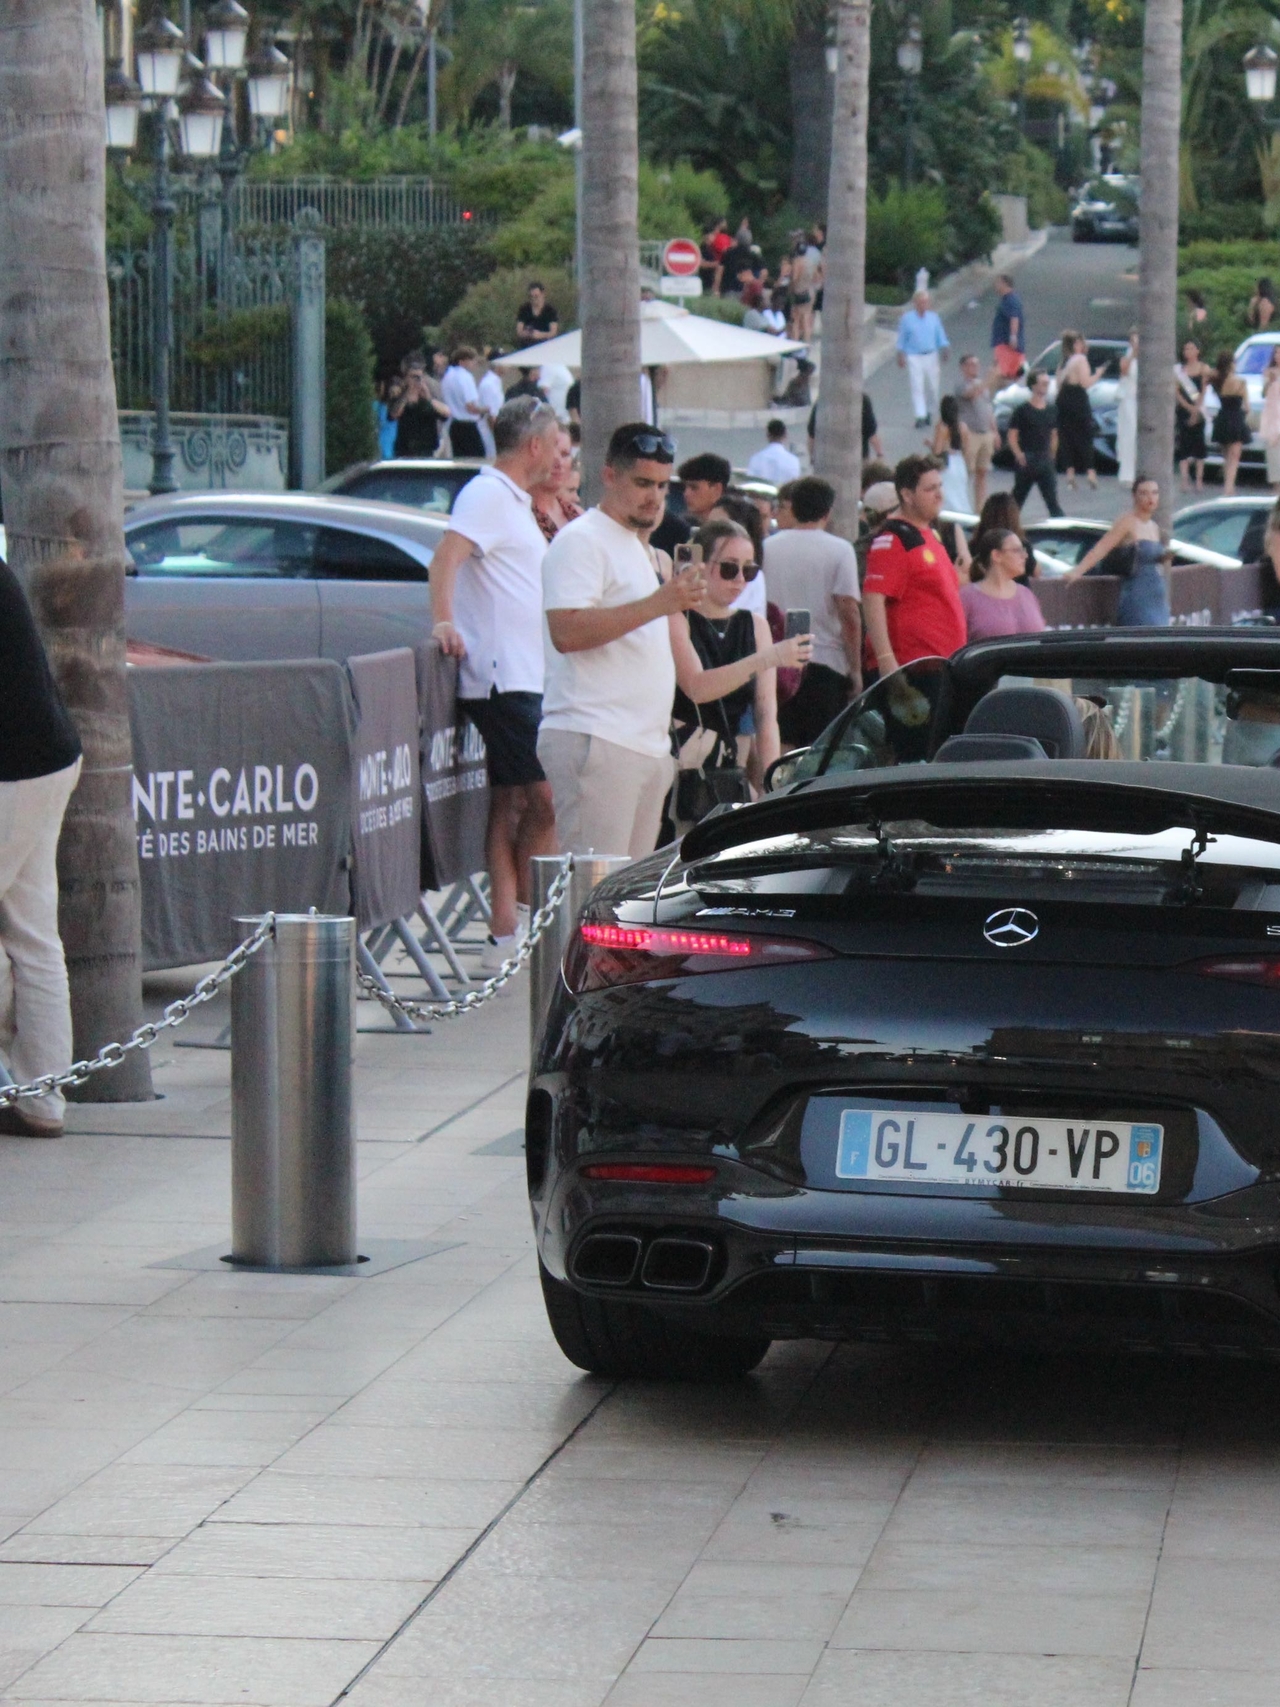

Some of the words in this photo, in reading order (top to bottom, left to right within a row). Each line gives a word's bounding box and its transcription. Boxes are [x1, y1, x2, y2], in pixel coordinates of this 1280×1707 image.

[132, 770, 195, 823] NTE
[209, 763, 319, 817] CARLO
[159, 831, 191, 857] DES
[197, 826, 248, 854] BAINS
[253, 825, 276, 849] DE
[282, 822, 319, 847] MER
[874, 1118, 1120, 1180] GL-430-VP
[1129, 1161, 1156, 1186] 06
